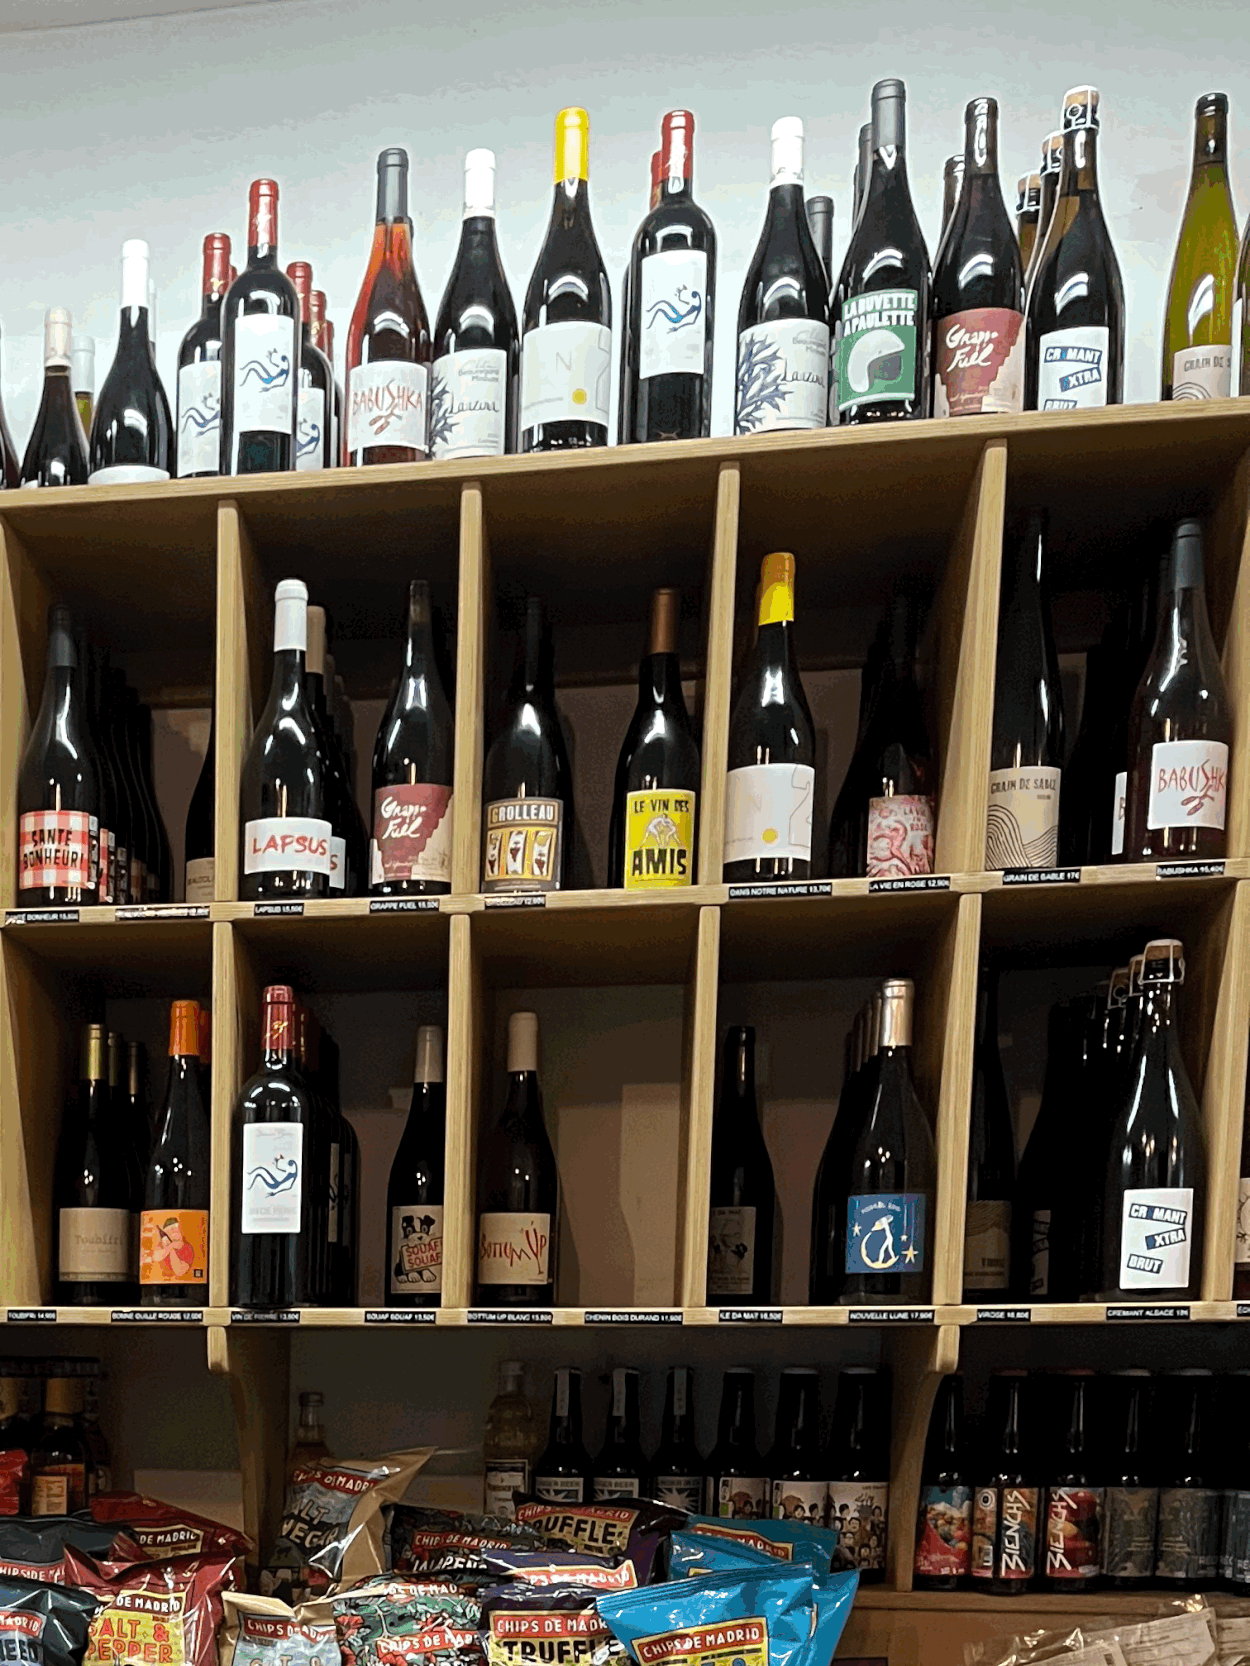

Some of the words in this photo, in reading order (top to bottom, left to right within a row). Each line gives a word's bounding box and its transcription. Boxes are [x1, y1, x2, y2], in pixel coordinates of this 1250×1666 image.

[490, 803, 555, 826] GROLLEAU
[634, 800, 645, 814] LE
[650, 799, 671, 813] VIN
[674, 798, 690, 813] DES
[252, 833, 328, 856] LAPSUS
[23, 846, 85, 871] BONHEUR!
[631, 848, 687, 877] AMIS
[879, 881, 892, 890] VIE
[1003, 873, 1028, 882] GRAIN
[751, 887, 776, 896] NOTRE
[777, 886, 808, 895] NATURE
[1128, 1255, 1163, 1273] BRUT
[116, 1595, 130, 1608] DE
[133, 1596, 181, 1612] MADRID
[152, 1624, 170, 1643] &
[247, 1619, 283, 1636] CHIPS
[497, 1619, 539, 1633] CHIPS
[544, 1619, 562, 1632] DE
[705, 1628, 760, 1647] MADRID
